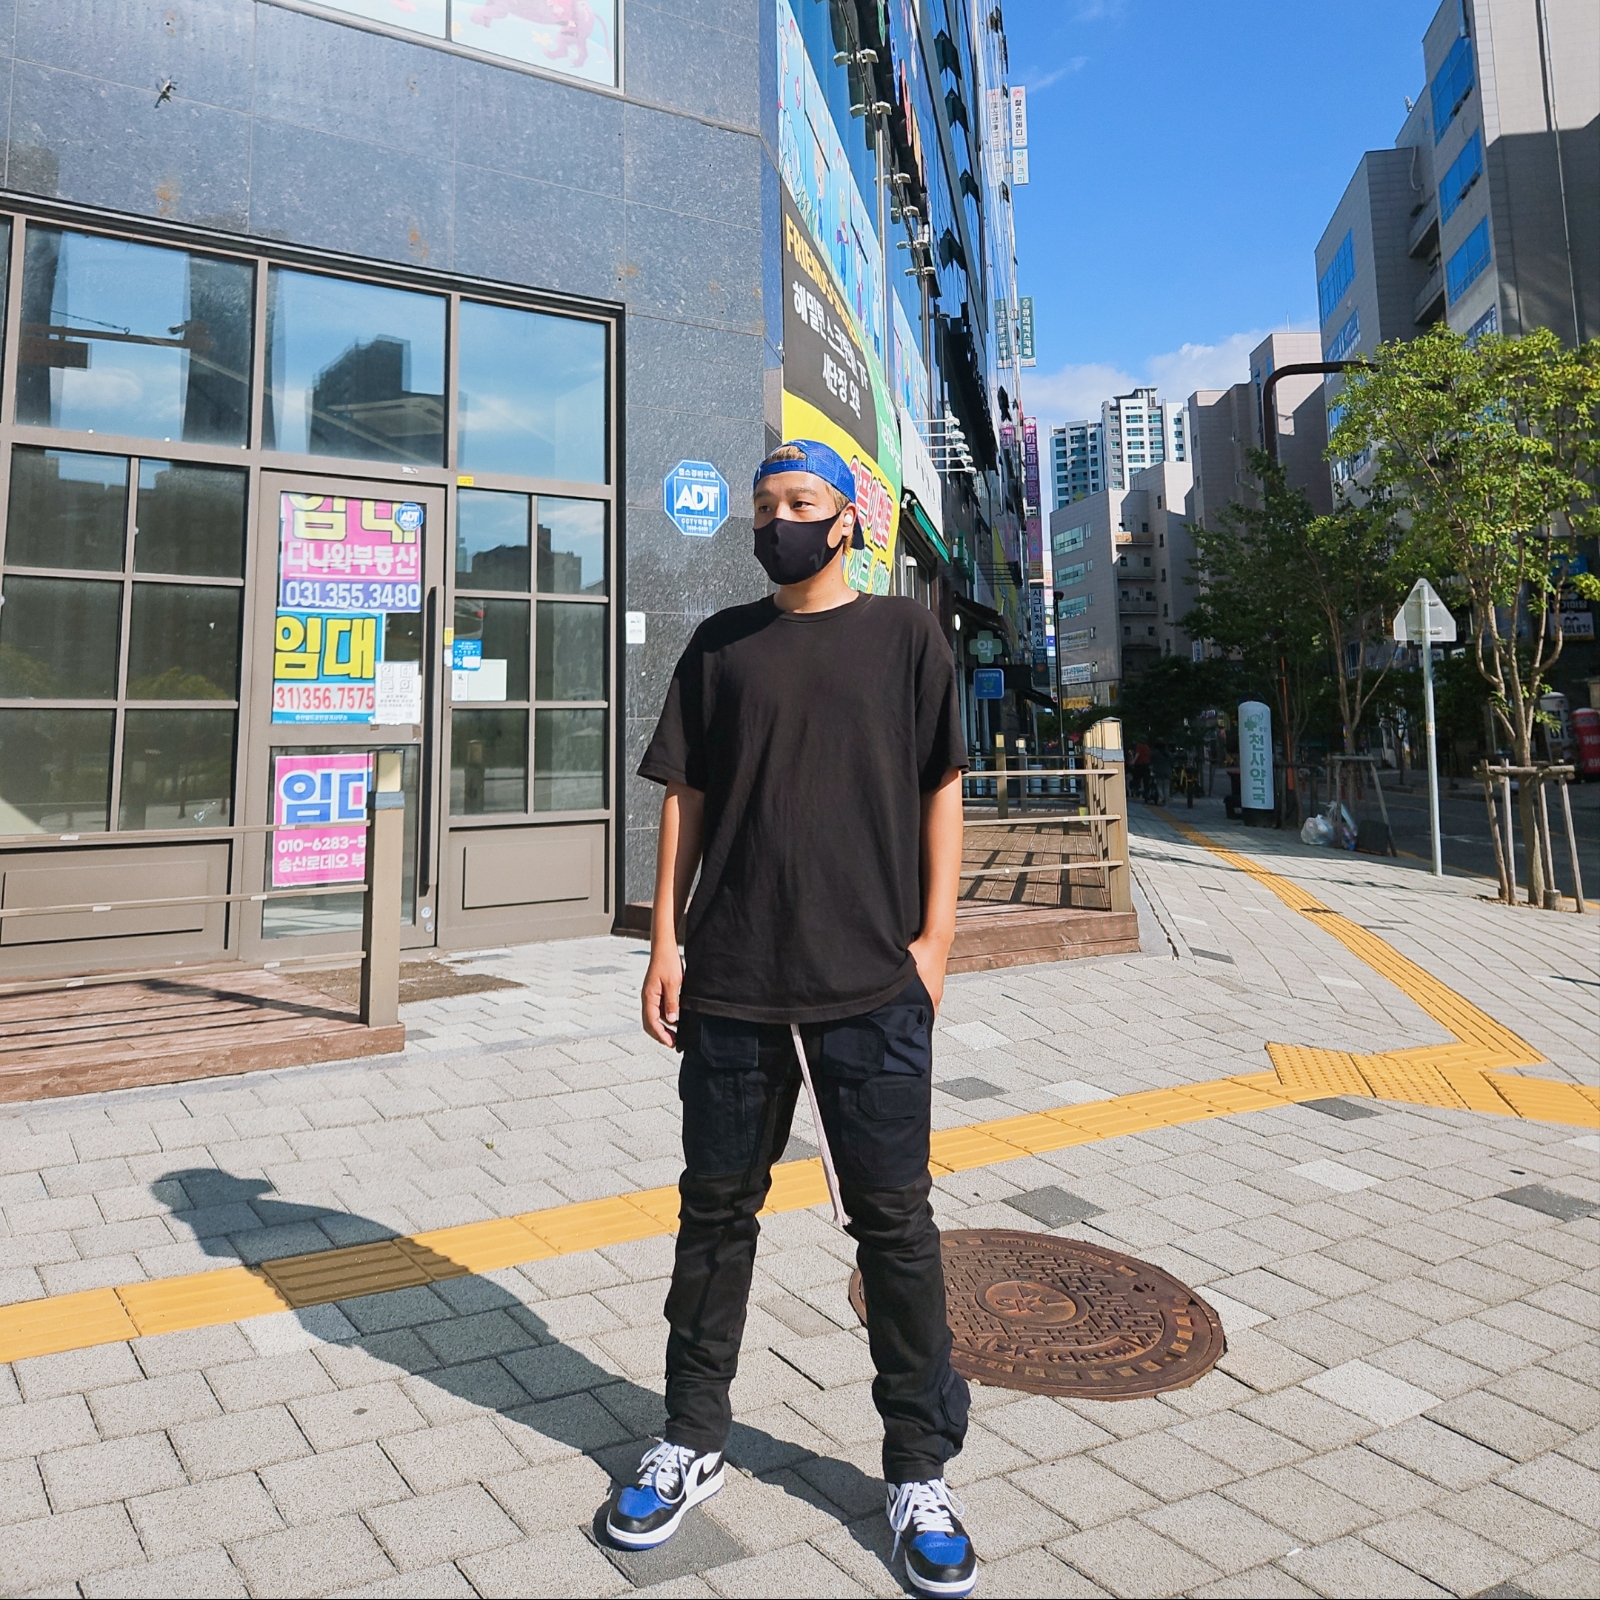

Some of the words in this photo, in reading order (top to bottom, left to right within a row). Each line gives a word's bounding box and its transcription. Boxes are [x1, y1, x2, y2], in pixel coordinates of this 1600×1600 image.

[785, 212, 833, 305] FRIENDS
[1025, 433, 1037, 464] 아로마
[676, 484, 719, 512] ADT
[400, 511, 420, 522] ADT
[287, 541, 417, 576] 다나와부동산
[285, 581, 421, 609] 031.355.3480
[1033, 589, 1044, 647] 시그니처독서실
[274, 616, 377, 680] 임대
[977, 640, 993, 657] 약
[1249, 733, 1266, 804] 천사약국
[278, 852, 349, 873] 송산로데오
